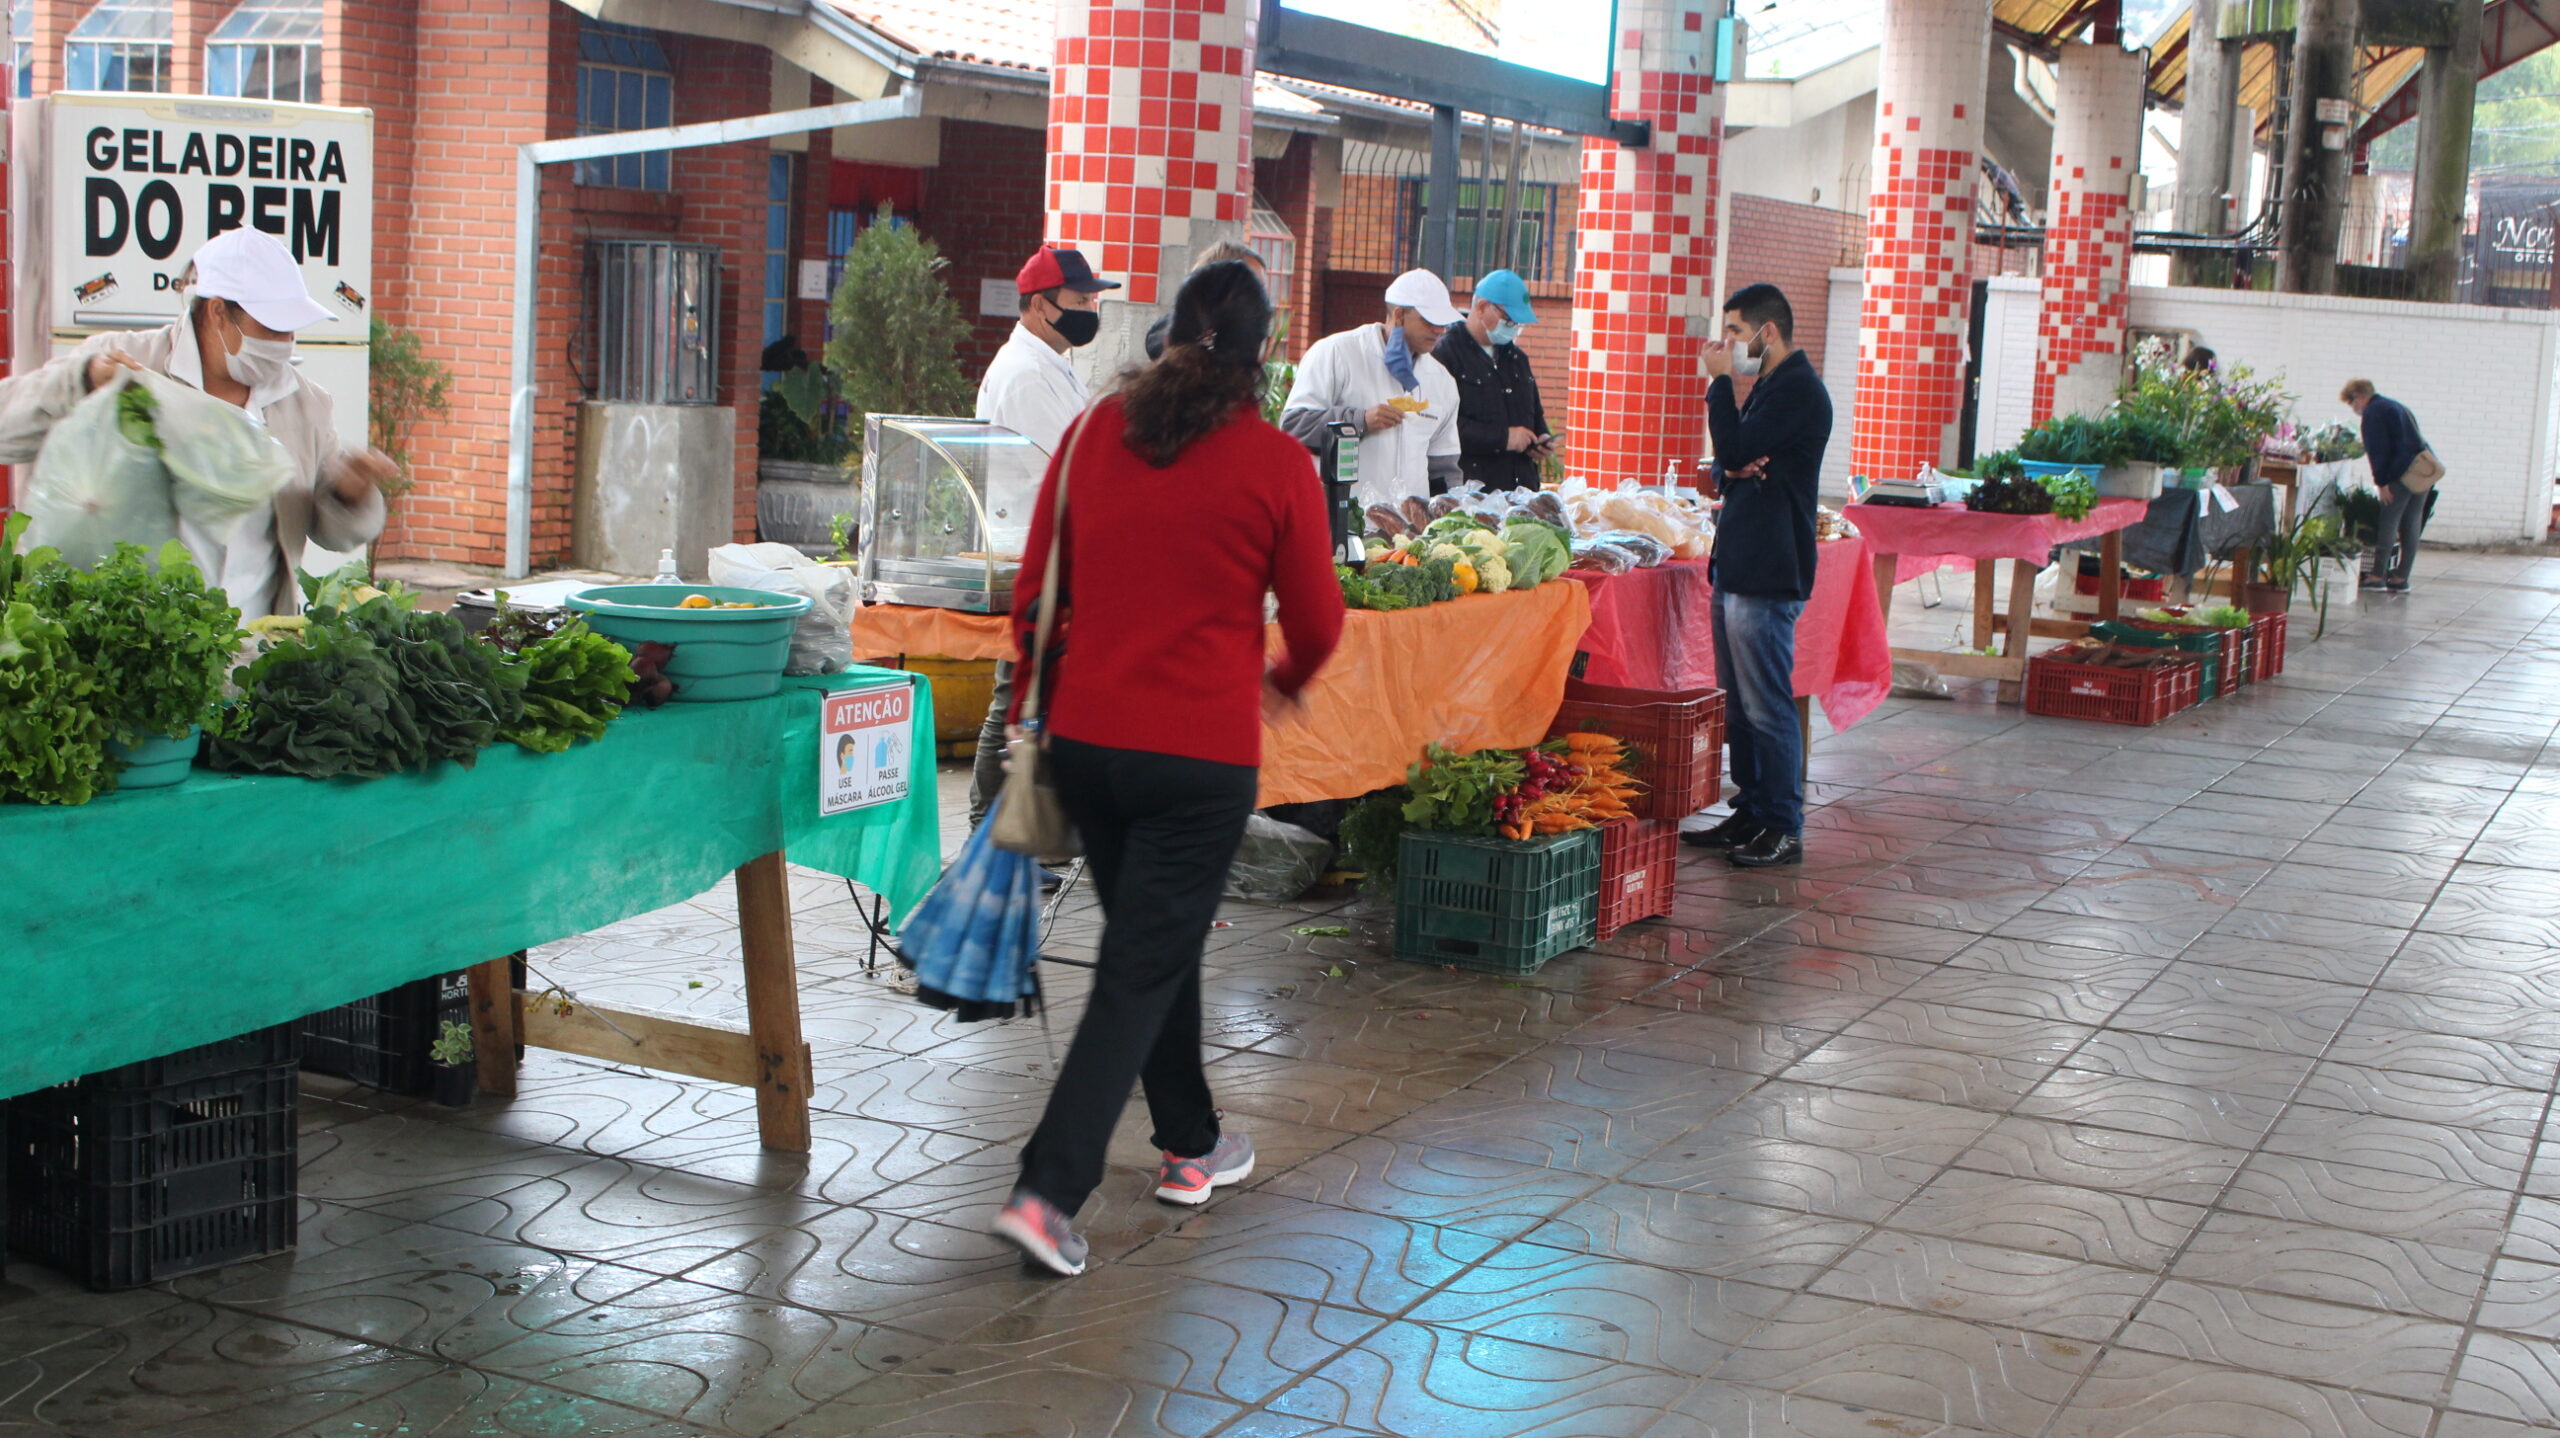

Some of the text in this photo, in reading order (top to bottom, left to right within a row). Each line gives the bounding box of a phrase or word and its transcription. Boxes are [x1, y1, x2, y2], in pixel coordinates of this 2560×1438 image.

[87, 126, 347, 184] GELADEIRA
[85, 177, 183, 260] DO
[834, 694, 902, 726] ATENÇÃO
[838, 776, 852, 789] USE
[878, 767, 899, 781] PASSE
[827, 789, 863, 808] MÁSCARA
[867, 780, 908, 799] ÁLCOOL GEL
